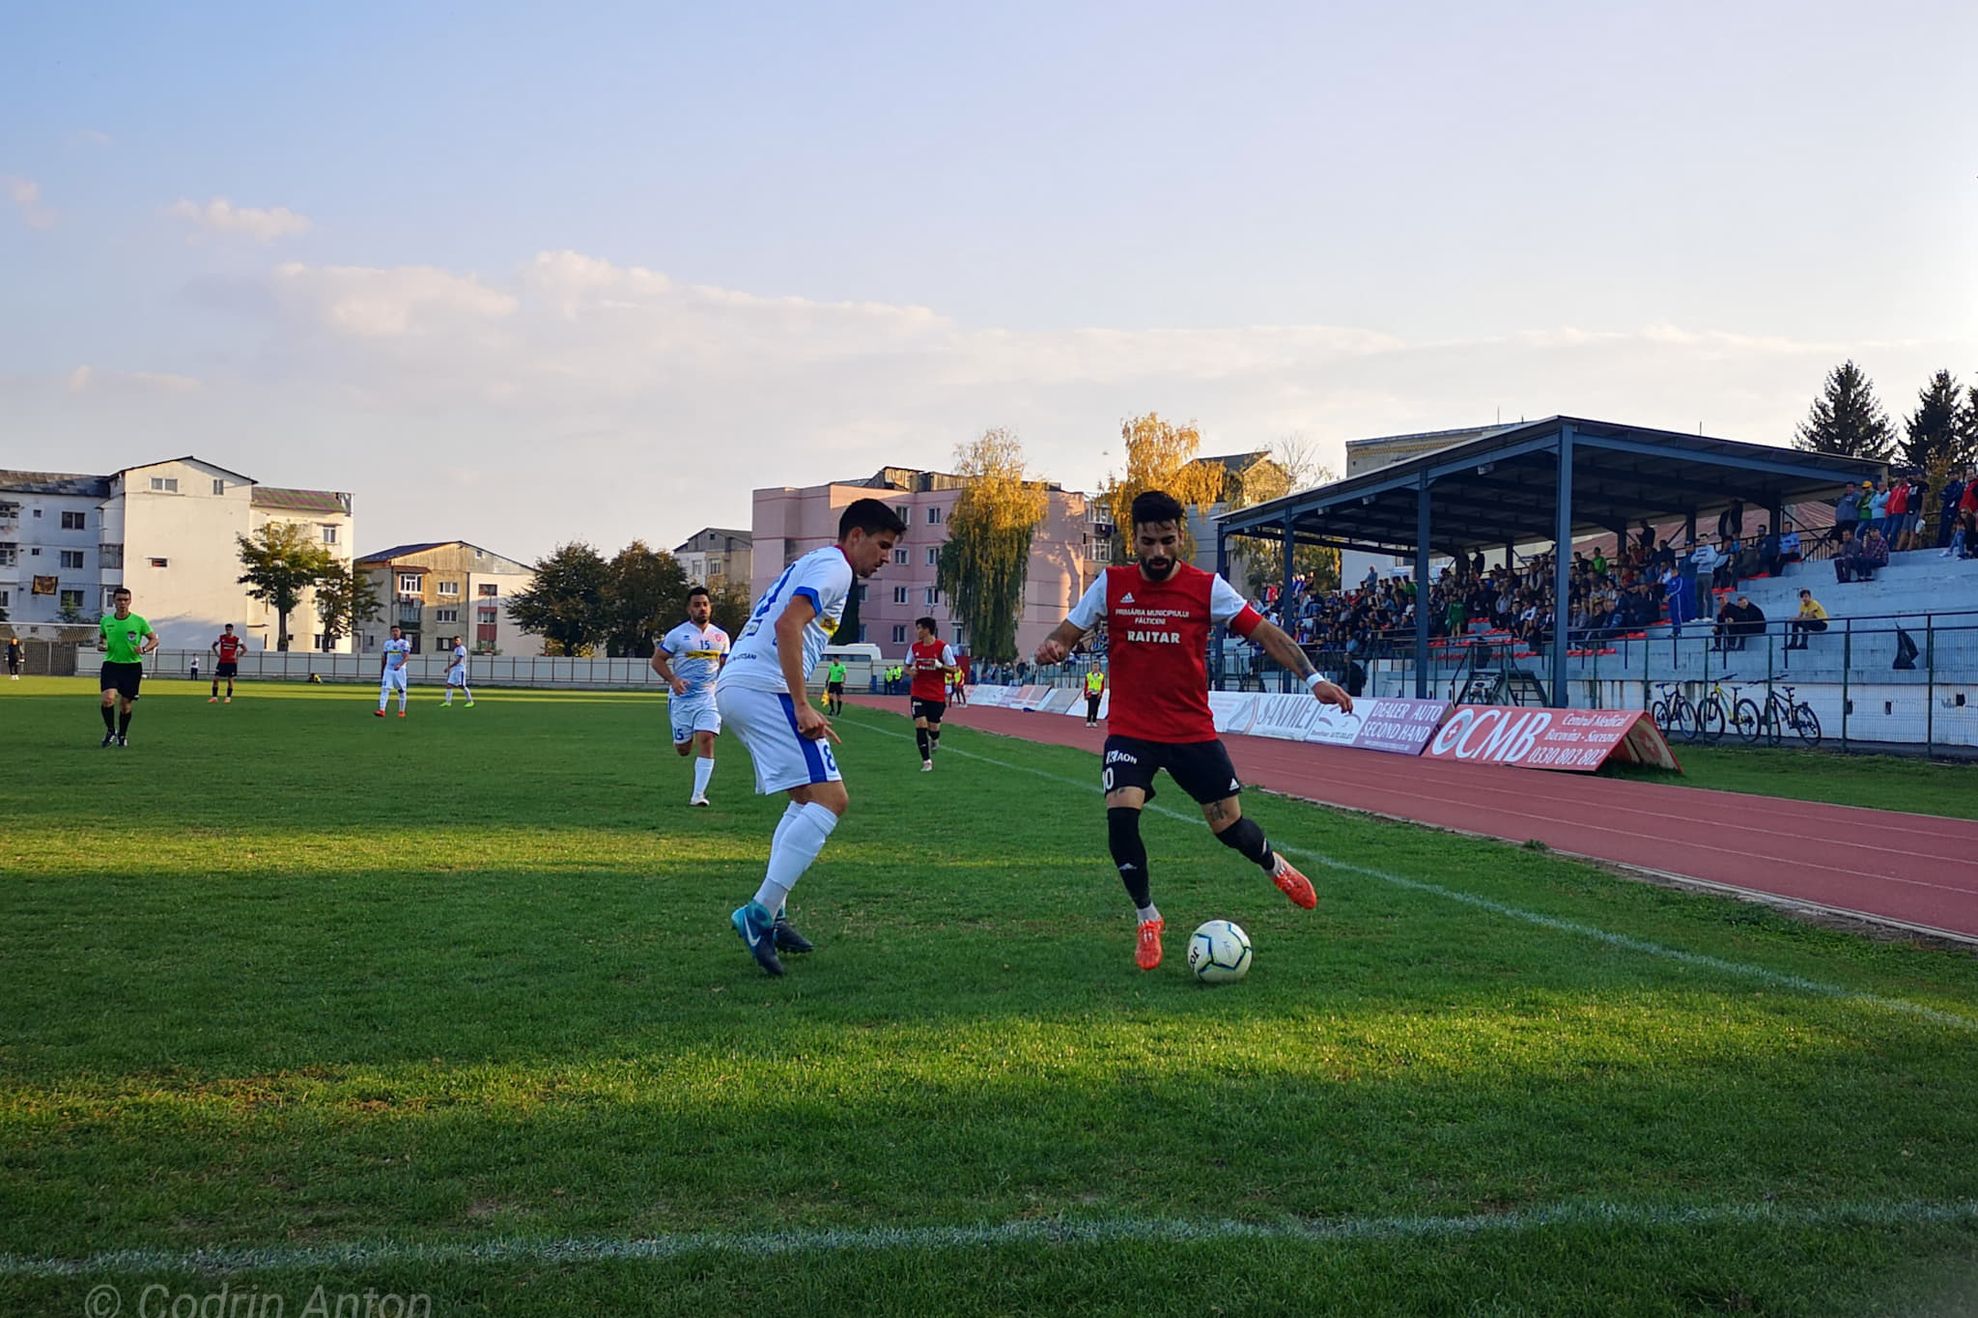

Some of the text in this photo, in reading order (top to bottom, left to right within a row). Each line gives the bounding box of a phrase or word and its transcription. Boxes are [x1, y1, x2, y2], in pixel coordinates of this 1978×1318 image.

[1127, 630, 1181, 644] RAITAR
[700, 640, 711, 650] 15
[1372, 702, 1443, 721] DEALER AUTO
[1562, 713, 1631, 727] Central Medical
[673, 728, 684, 740] 15
[1360, 721, 1400, 740] SECOND
[1398, 724, 1431, 742] HAND
[1527, 746, 1607, 765] 0330 803 802
